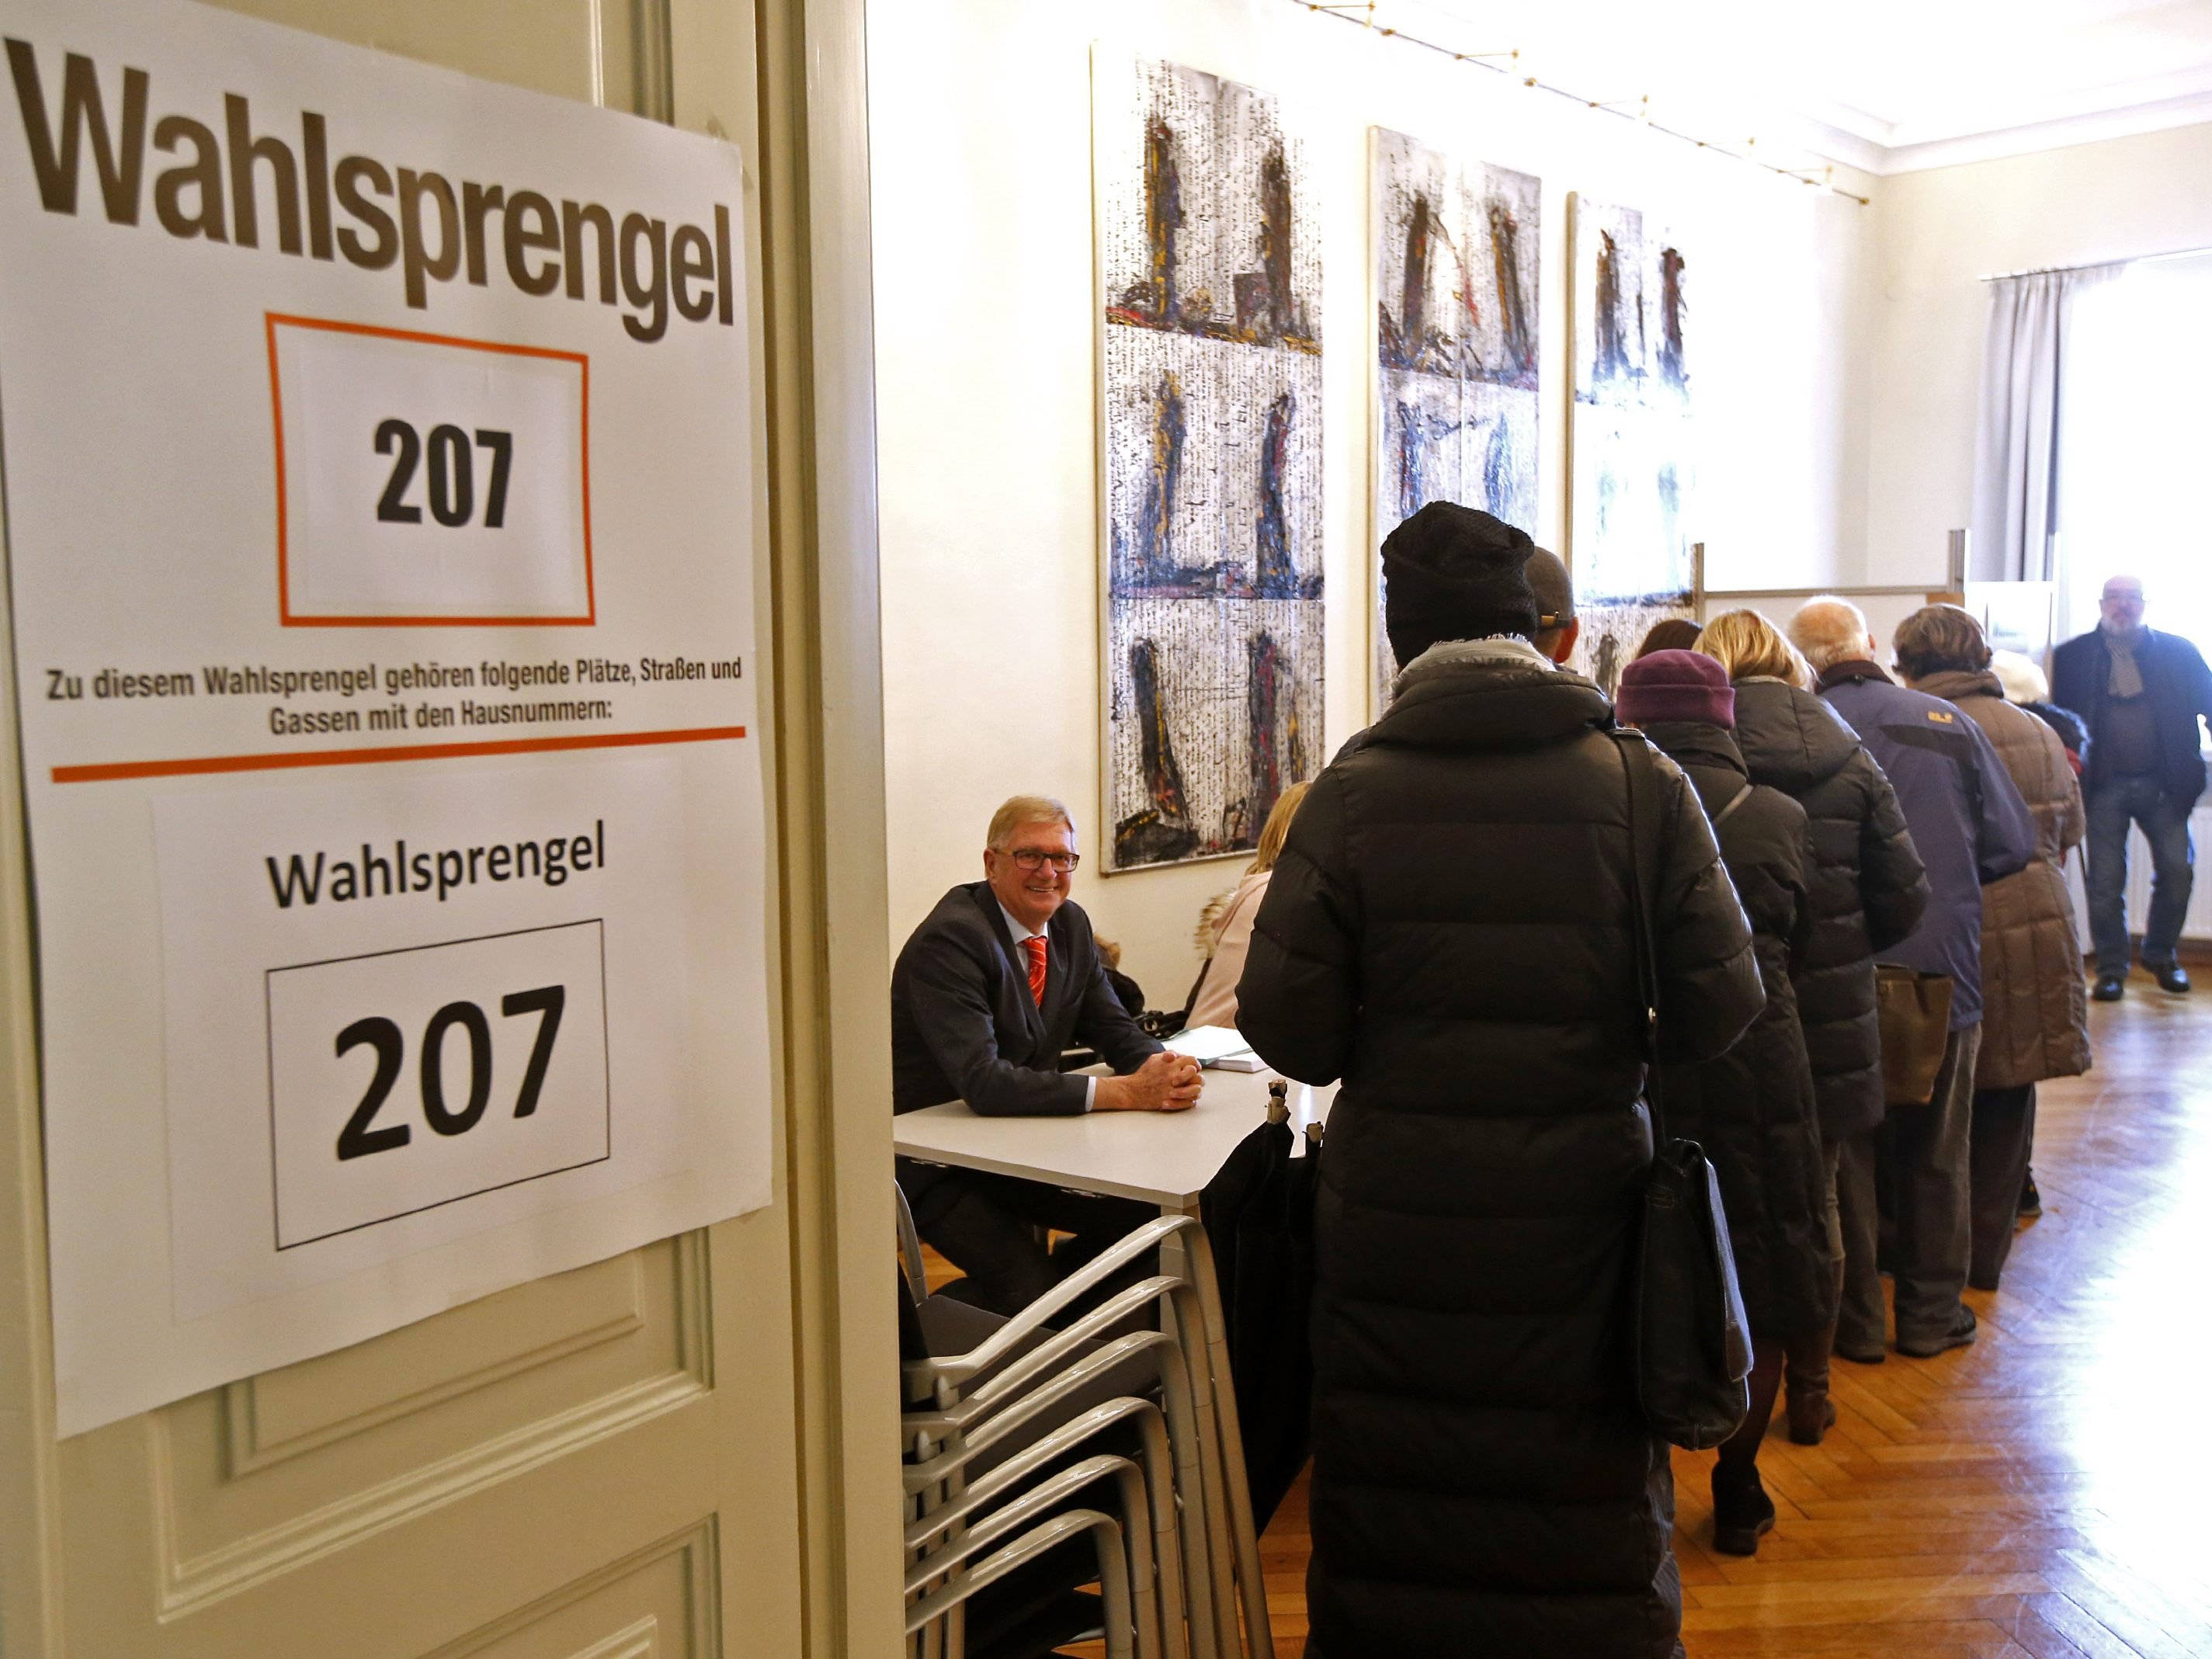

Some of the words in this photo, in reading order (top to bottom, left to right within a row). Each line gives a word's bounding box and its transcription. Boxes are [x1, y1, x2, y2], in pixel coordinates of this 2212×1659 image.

[3, 36, 734, 343] Wahlsprengel
[373, 418, 512, 529] 207
[46, 668, 83, 700] Zu
[92, 668, 196, 699] diesem
[202, 663, 377, 699] Wahlsprengel
[384, 662, 475, 696] gehören
[480, 660, 571, 692] folgende
[576, 658, 637, 685] Plätze,
[639, 657, 707, 682] Straßen
[710, 655, 742, 680] und
[269, 706, 361, 736] Gassen
[367, 703, 409, 731] mit
[414, 702, 455, 730] den
[461, 699, 613, 726] Hausnummern:
[265, 819, 606, 909] Wahlsprengel
[335, 984, 565, 1161] 207
